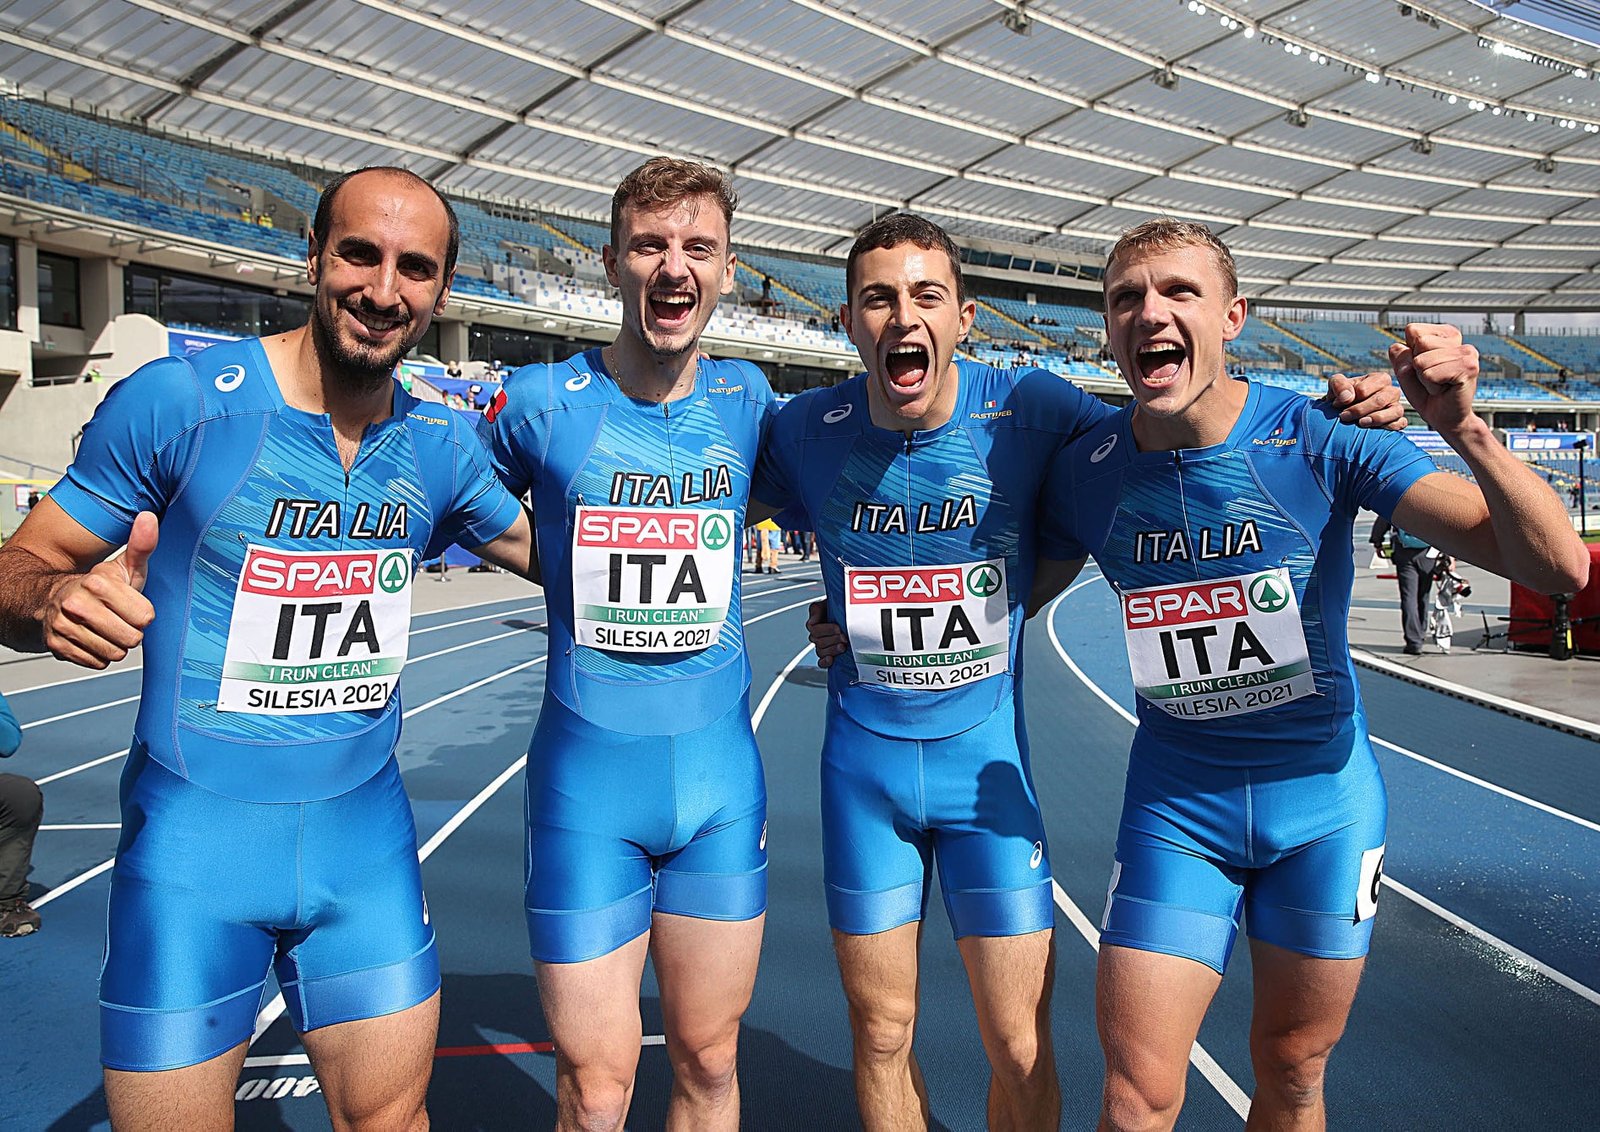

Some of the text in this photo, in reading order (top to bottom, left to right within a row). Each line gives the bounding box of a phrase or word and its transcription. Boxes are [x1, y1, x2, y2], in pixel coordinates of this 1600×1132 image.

[970, 409, 1013, 420] FASTWEB
[581, 515, 696, 545] SPAR
[247, 556, 374, 592] SPAR
[607, 553, 708, 605] ITA
[852, 571, 962, 600] SPAR
[616, 609, 649, 623] RUN
[1128, 587, 1244, 626] SPAR
[271, 599, 381, 661] ITA
[595, 627, 711, 648] SILESIA 2021
[879, 604, 982, 652] ITA
[893, 654, 923, 667] RUN
[1158, 621, 1276, 681] ITA
[279, 665, 318, 682] RUN
[875, 661, 991, 686] SILESIA 2021
[247, 682, 389, 709] SILESIA 2021
[1163, 683, 1294, 717] SILESIA 2021
[1180, 681, 1214, 696] RUN
